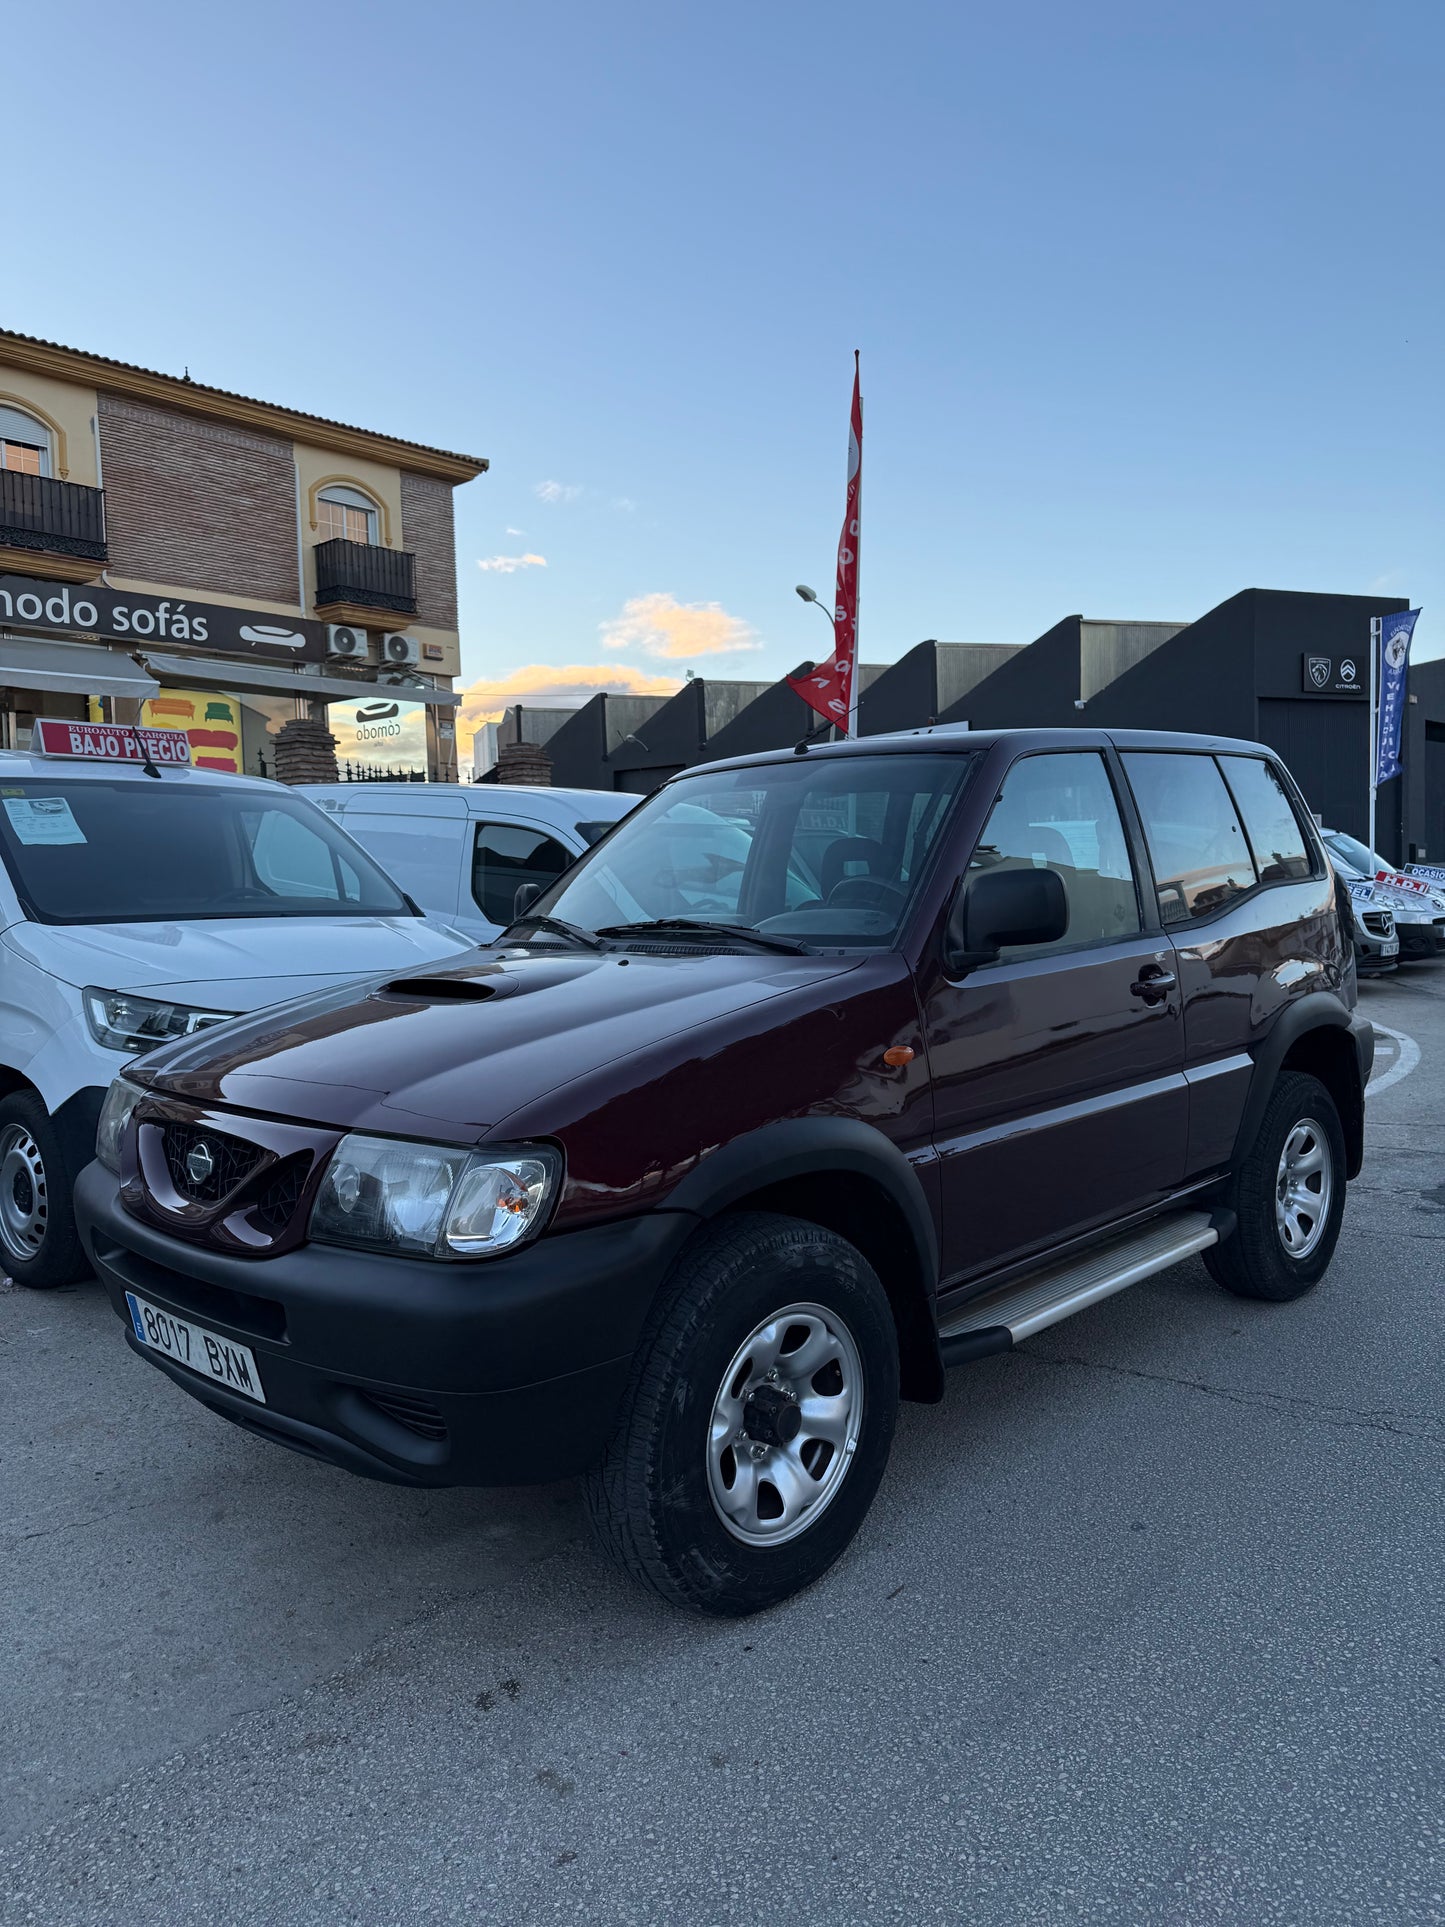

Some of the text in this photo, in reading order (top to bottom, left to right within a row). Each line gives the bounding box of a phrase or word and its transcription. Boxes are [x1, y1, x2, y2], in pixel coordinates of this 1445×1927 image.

[112, 602, 209, 641] sofás
[68, 725, 129, 737] EUROAUTO
[69, 733, 190, 761] BAJO PRECIO
[144, 1307, 190, 1361] 8017
[203, 1335, 255, 1393] BXM
